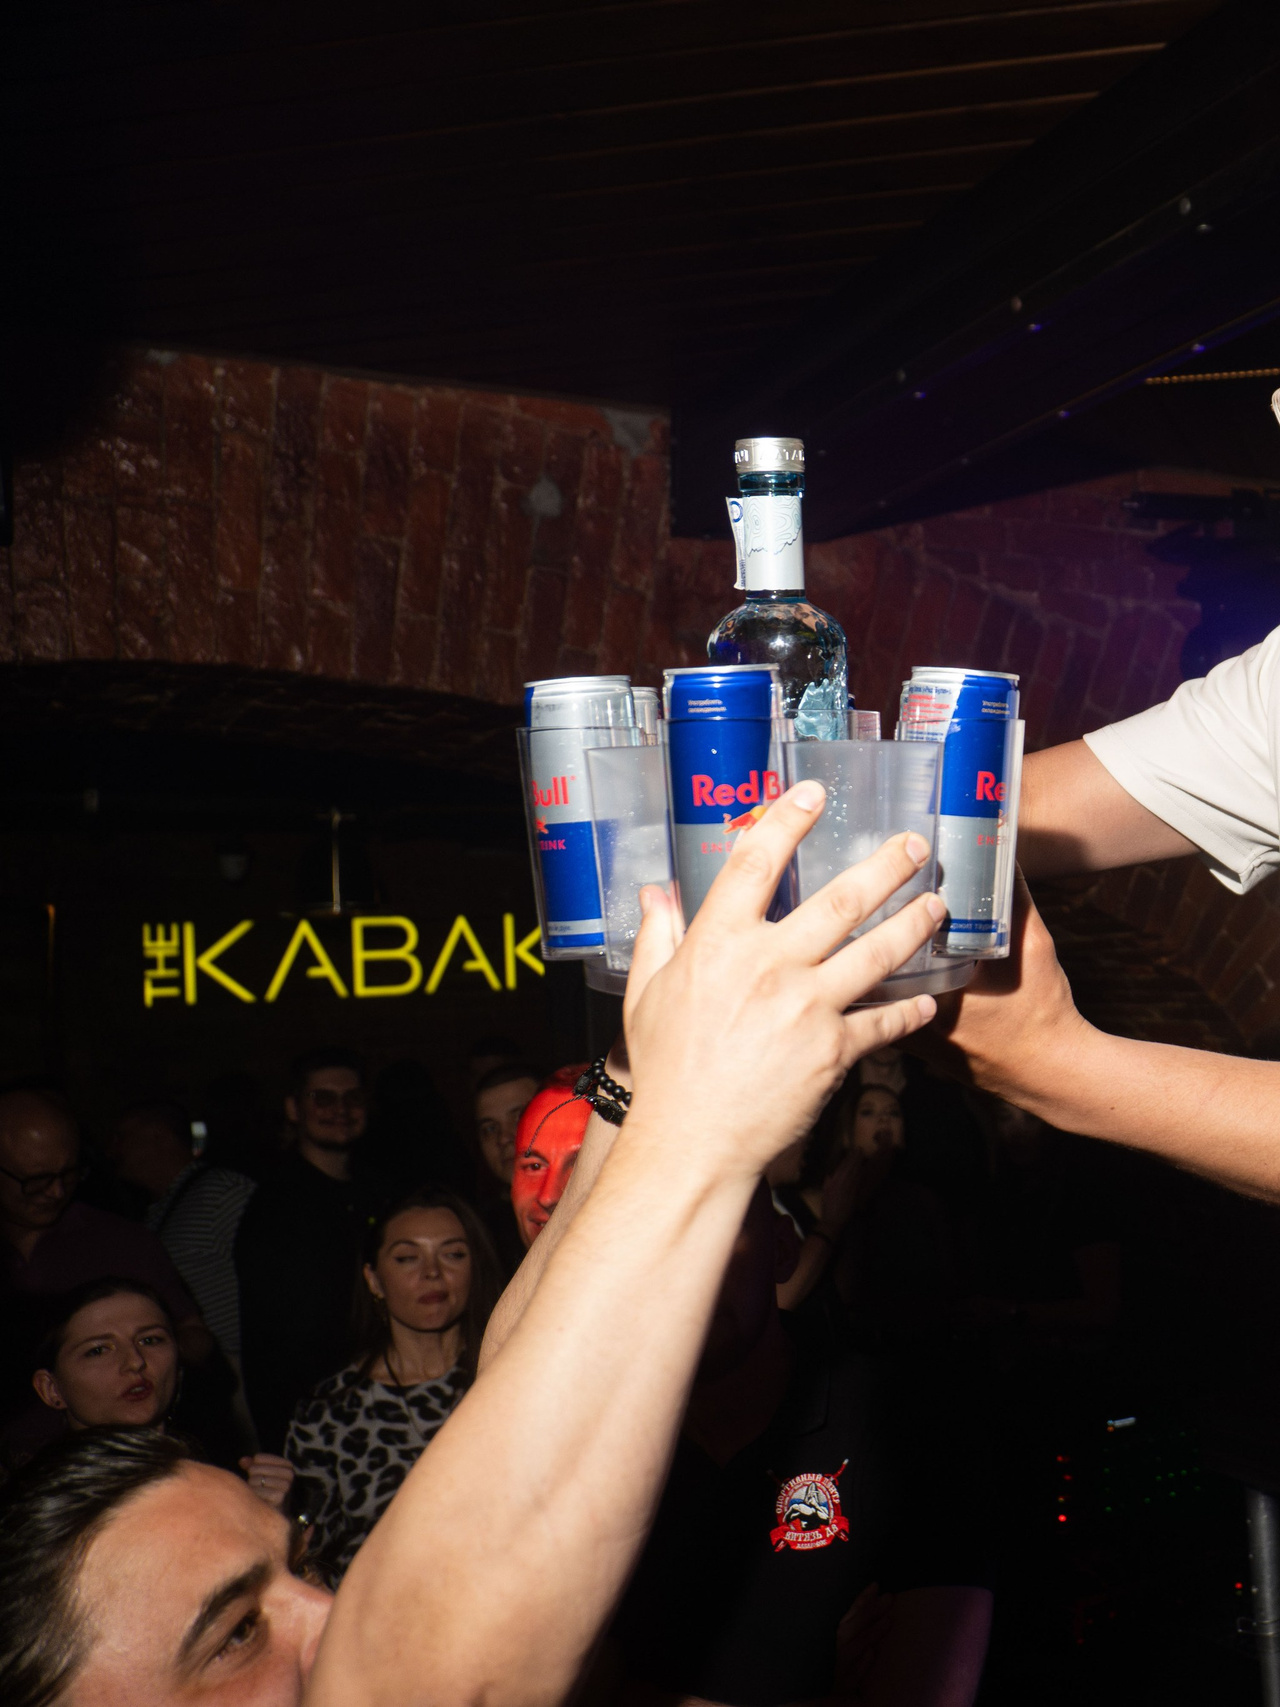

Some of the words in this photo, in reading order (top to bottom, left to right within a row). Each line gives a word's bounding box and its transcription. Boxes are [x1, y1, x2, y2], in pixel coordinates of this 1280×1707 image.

[691, 770, 760, 807] Red
[975, 770, 1007, 802] Re
[539, 838, 567, 851] RINK
[701, 841, 733, 854] ENE
[142, 921, 182, 1008] THE
[183, 912, 546, 1006] KABAK
[784, 1530, 823, 1542] ВИТЯЗЬ
